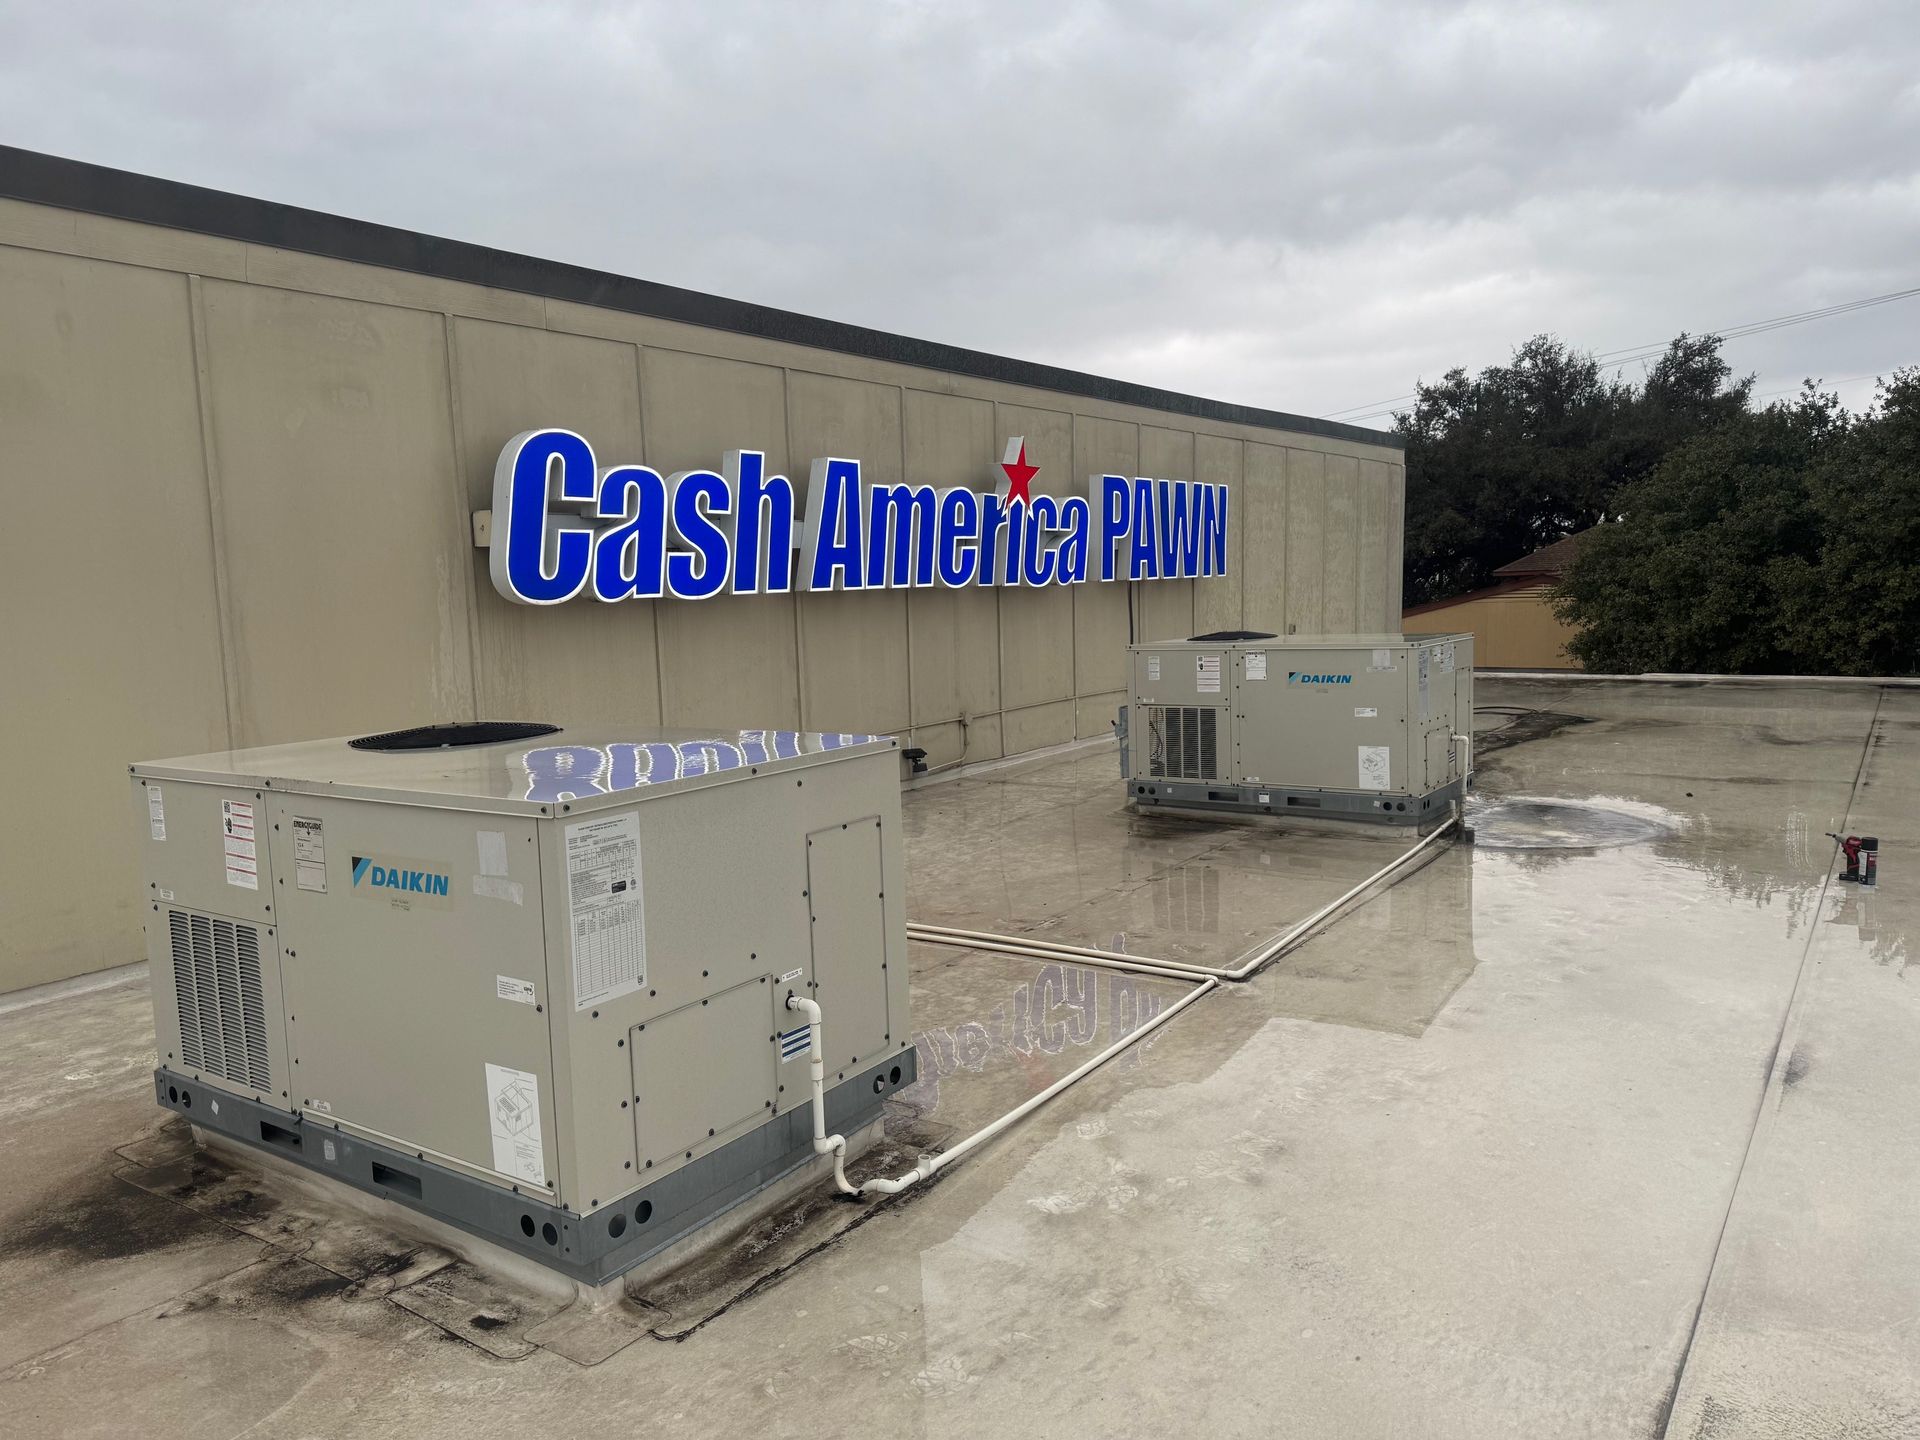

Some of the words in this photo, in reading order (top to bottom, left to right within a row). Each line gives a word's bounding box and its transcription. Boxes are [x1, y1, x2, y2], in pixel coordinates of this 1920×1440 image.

[504, 427, 795, 604] Cash
[809, 437, 1090, 592] America
[1100, 474, 1229, 583] PAWN
[1300, 674, 1352, 684] DAIKIN
[370, 866, 449, 896] DAIKIN
